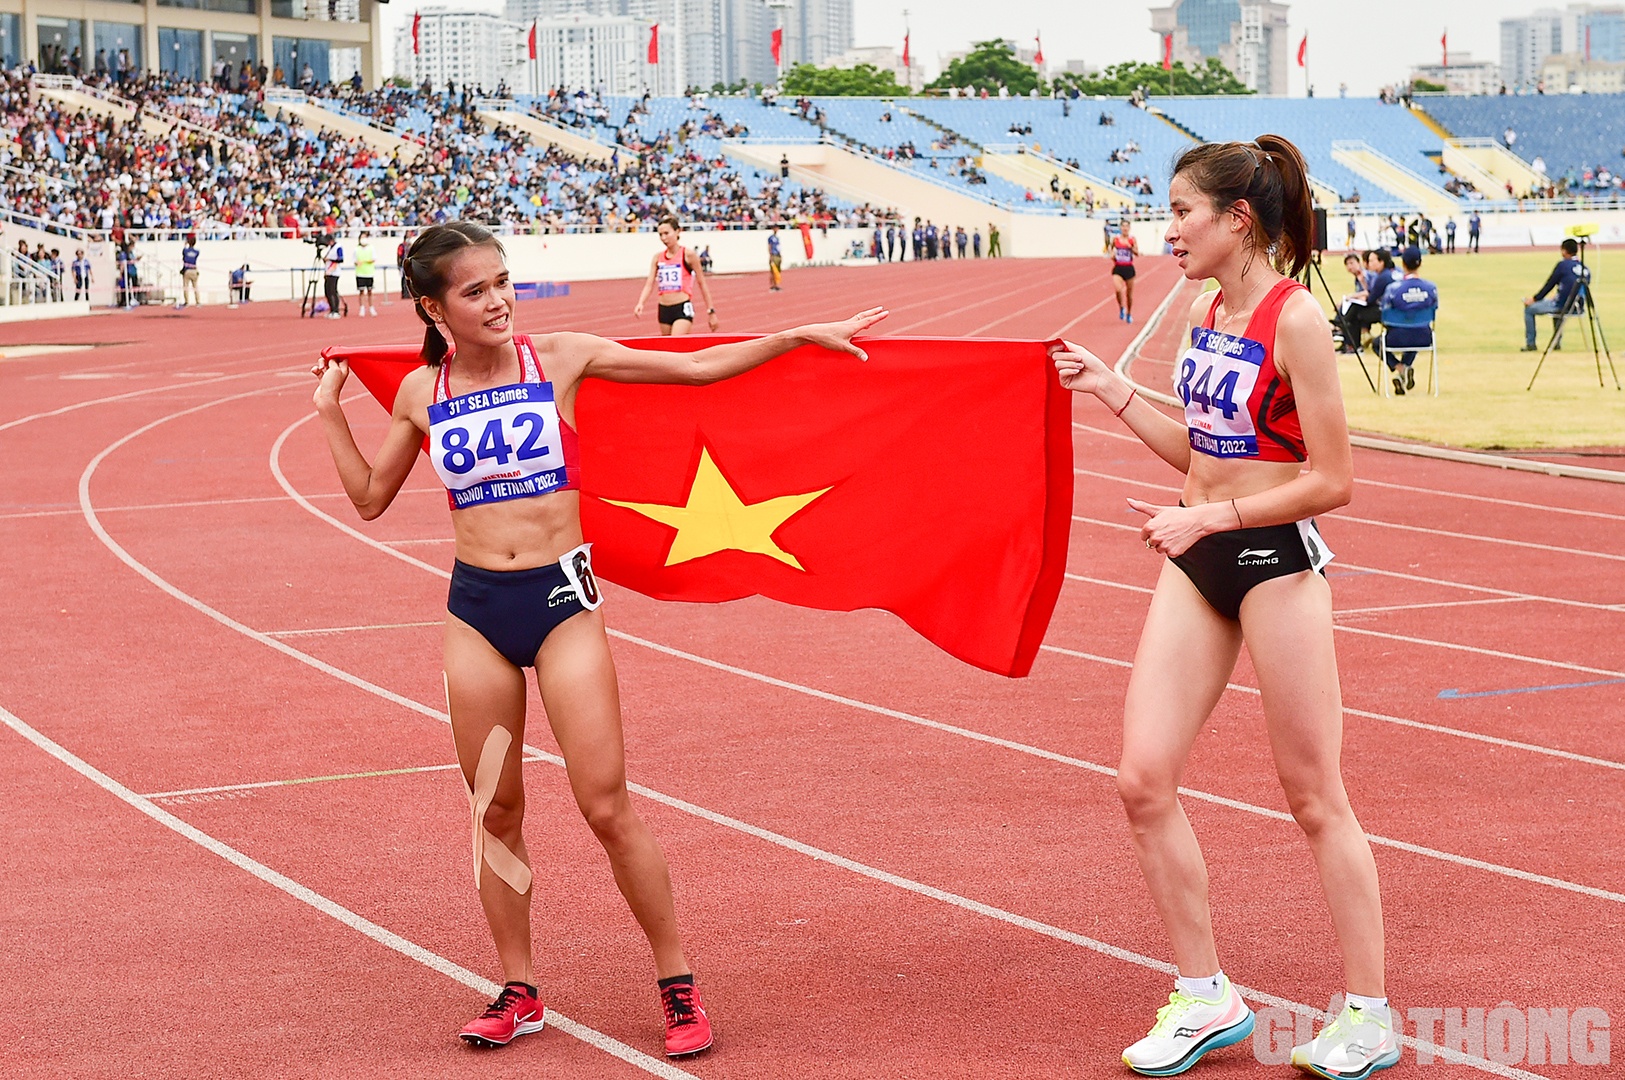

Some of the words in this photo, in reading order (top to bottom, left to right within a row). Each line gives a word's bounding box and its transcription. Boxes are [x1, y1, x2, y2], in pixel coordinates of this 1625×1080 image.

[468, 394, 491, 411] SEA
[492, 388, 529, 406] Games
[1177, 357, 1240, 420] 844
[441, 412, 550, 474] 842
[1192, 431, 1219, 454] VIETNAM
[1220, 439, 1247, 454] 2022
[481, 469, 522, 481] VIETNAM
[455, 490, 485, 506] HANOI
[491, 479, 536, 499] VIETNAM
[535, 472, 559, 491] 2022
[1237, 557, 1280, 566] LI-NING
